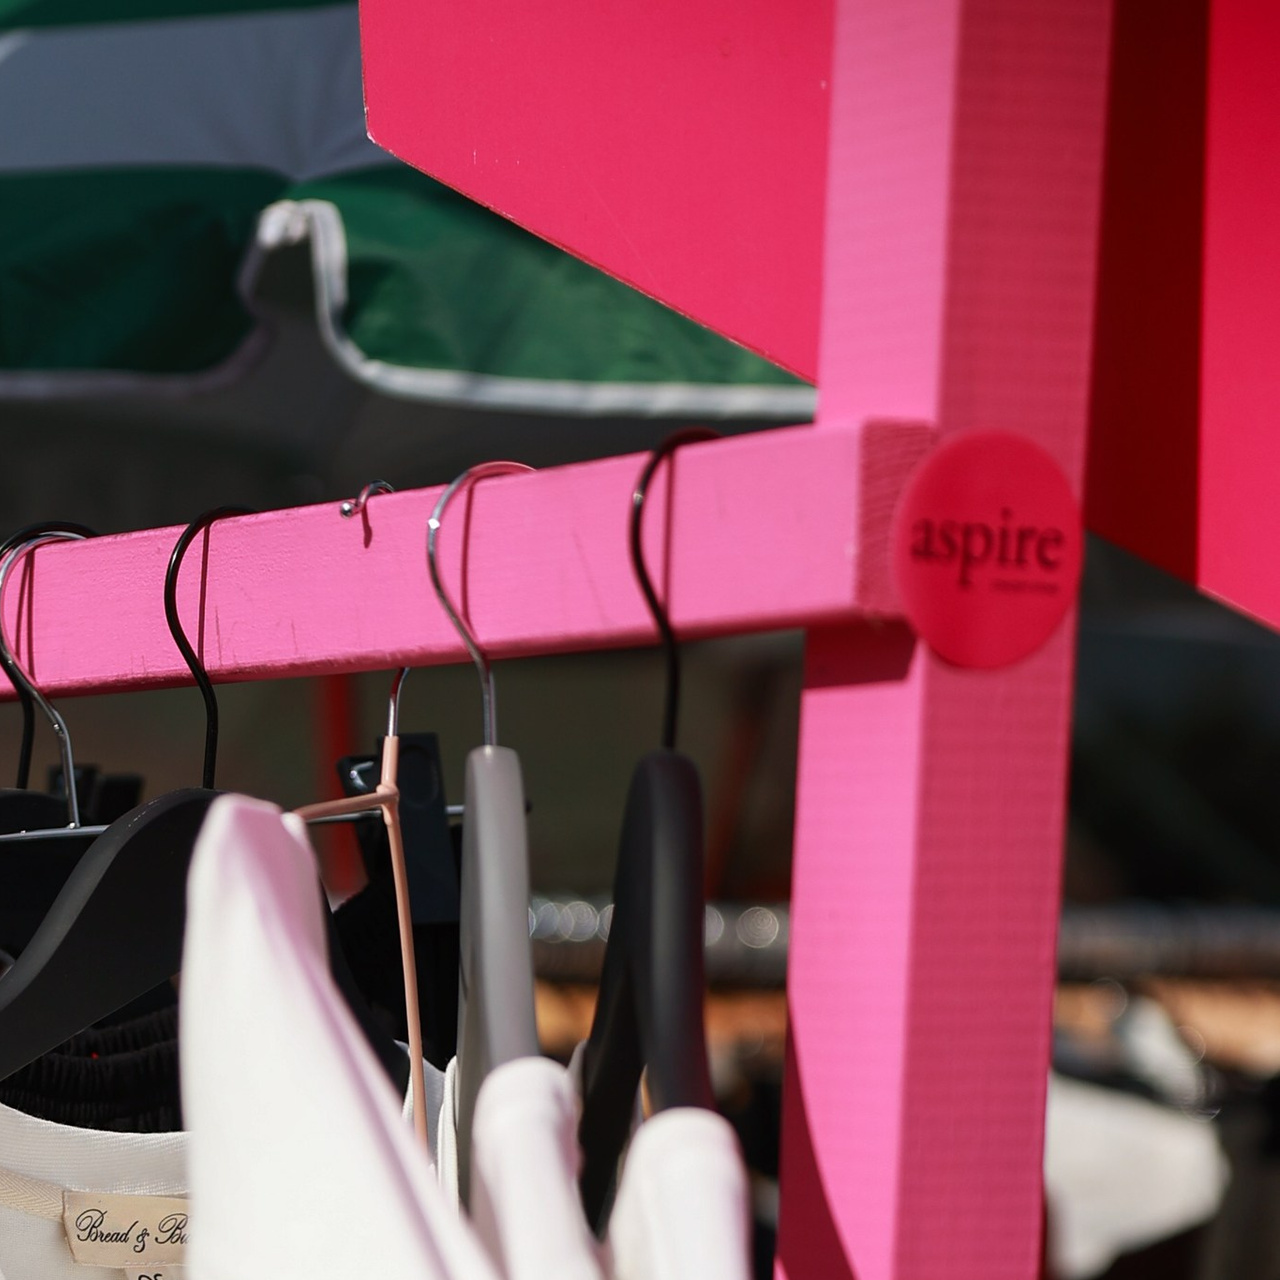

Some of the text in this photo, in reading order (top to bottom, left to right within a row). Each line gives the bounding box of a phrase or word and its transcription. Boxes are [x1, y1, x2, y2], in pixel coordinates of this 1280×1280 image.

[911, 508, 1065, 588] aspire
[75, 1208, 138, 1243] Bread
[133, 1221, 150, 1253] &
